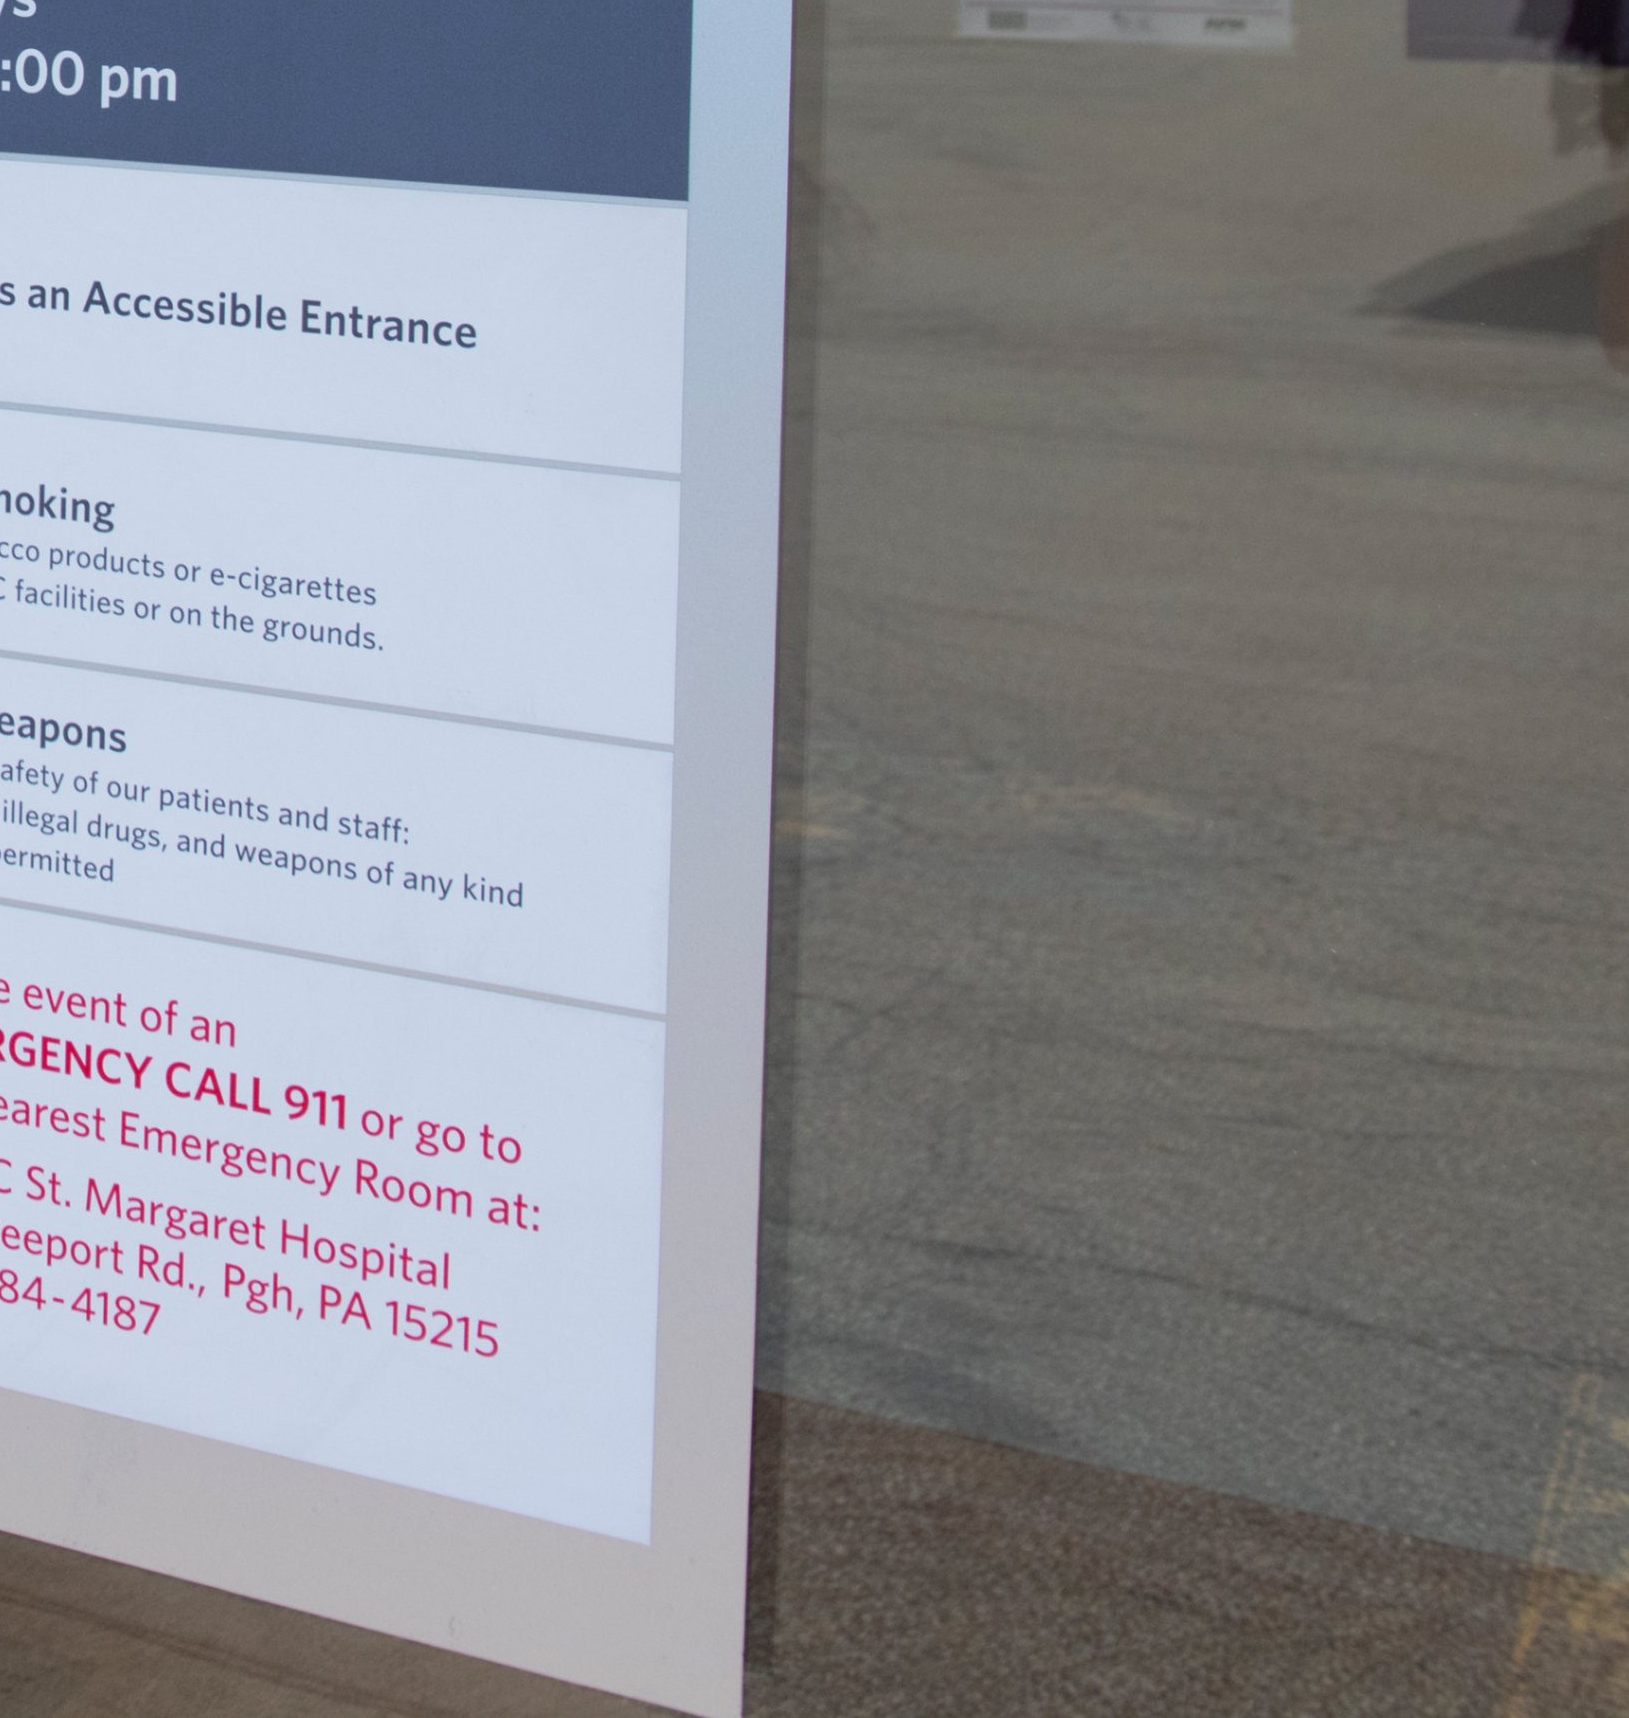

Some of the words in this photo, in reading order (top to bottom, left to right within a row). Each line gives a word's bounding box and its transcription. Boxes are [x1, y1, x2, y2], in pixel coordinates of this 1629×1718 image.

[101, 65, 176, 108] pm
[28, 285, 69, 311] an
[83, 281, 286, 330] Accessible
[302, 299, 476, 348] Entrance
[50, 547, 164, 578] products
[174, 564, 201, 582] or
[210, 567, 376, 605] e-cigarettes
[16, 579, 124, 616] facilities
[134, 602, 161, 620] or
[170, 606, 201, 626] on
[211, 605, 254, 633] the
[263, 619, 383, 651] grounds.
[73, 771, 98, 794] of
[107, 781, 150, 802] our
[160, 789, 269, 822] patients
[279, 807, 328, 831] and
[339, 814, 408, 844] staff:
[4, 800, 77, 835] illegal
[87, 814, 167, 852] drugs,
[177, 834, 225, 858] and
[235, 844, 357, 880] weapons
[367, 861, 394, 886] of
[403, 872, 453, 901] any
[464, 873, 523, 908] kind
[23, 985, 126, 1027] event
[140, 1000, 178, 1035] of
[190, 1016, 235, 1047] an
[166, 1062, 271, 1114] CALL
[285, 1085, 345, 1129] 911
[362, 1110, 403, 1139] or
[416, 1121, 465, 1156] go
[480, 1124, 521, 1163] to
[121, 1111, 340, 1196] Emergency
[356, 1158, 472, 1217] Room
[488, 1194, 539, 1231] at:
[27, 1166, 70, 1207] St.
[86, 1178, 265, 1250] Margaret
[281, 1219, 449, 1289] Hospital
[139, 1244, 205, 1297] Rd.,
[225, 1263, 303, 1320] Pgh,
[320, 1284, 371, 1330] PA
[386, 1301, 498, 1357] 15215
